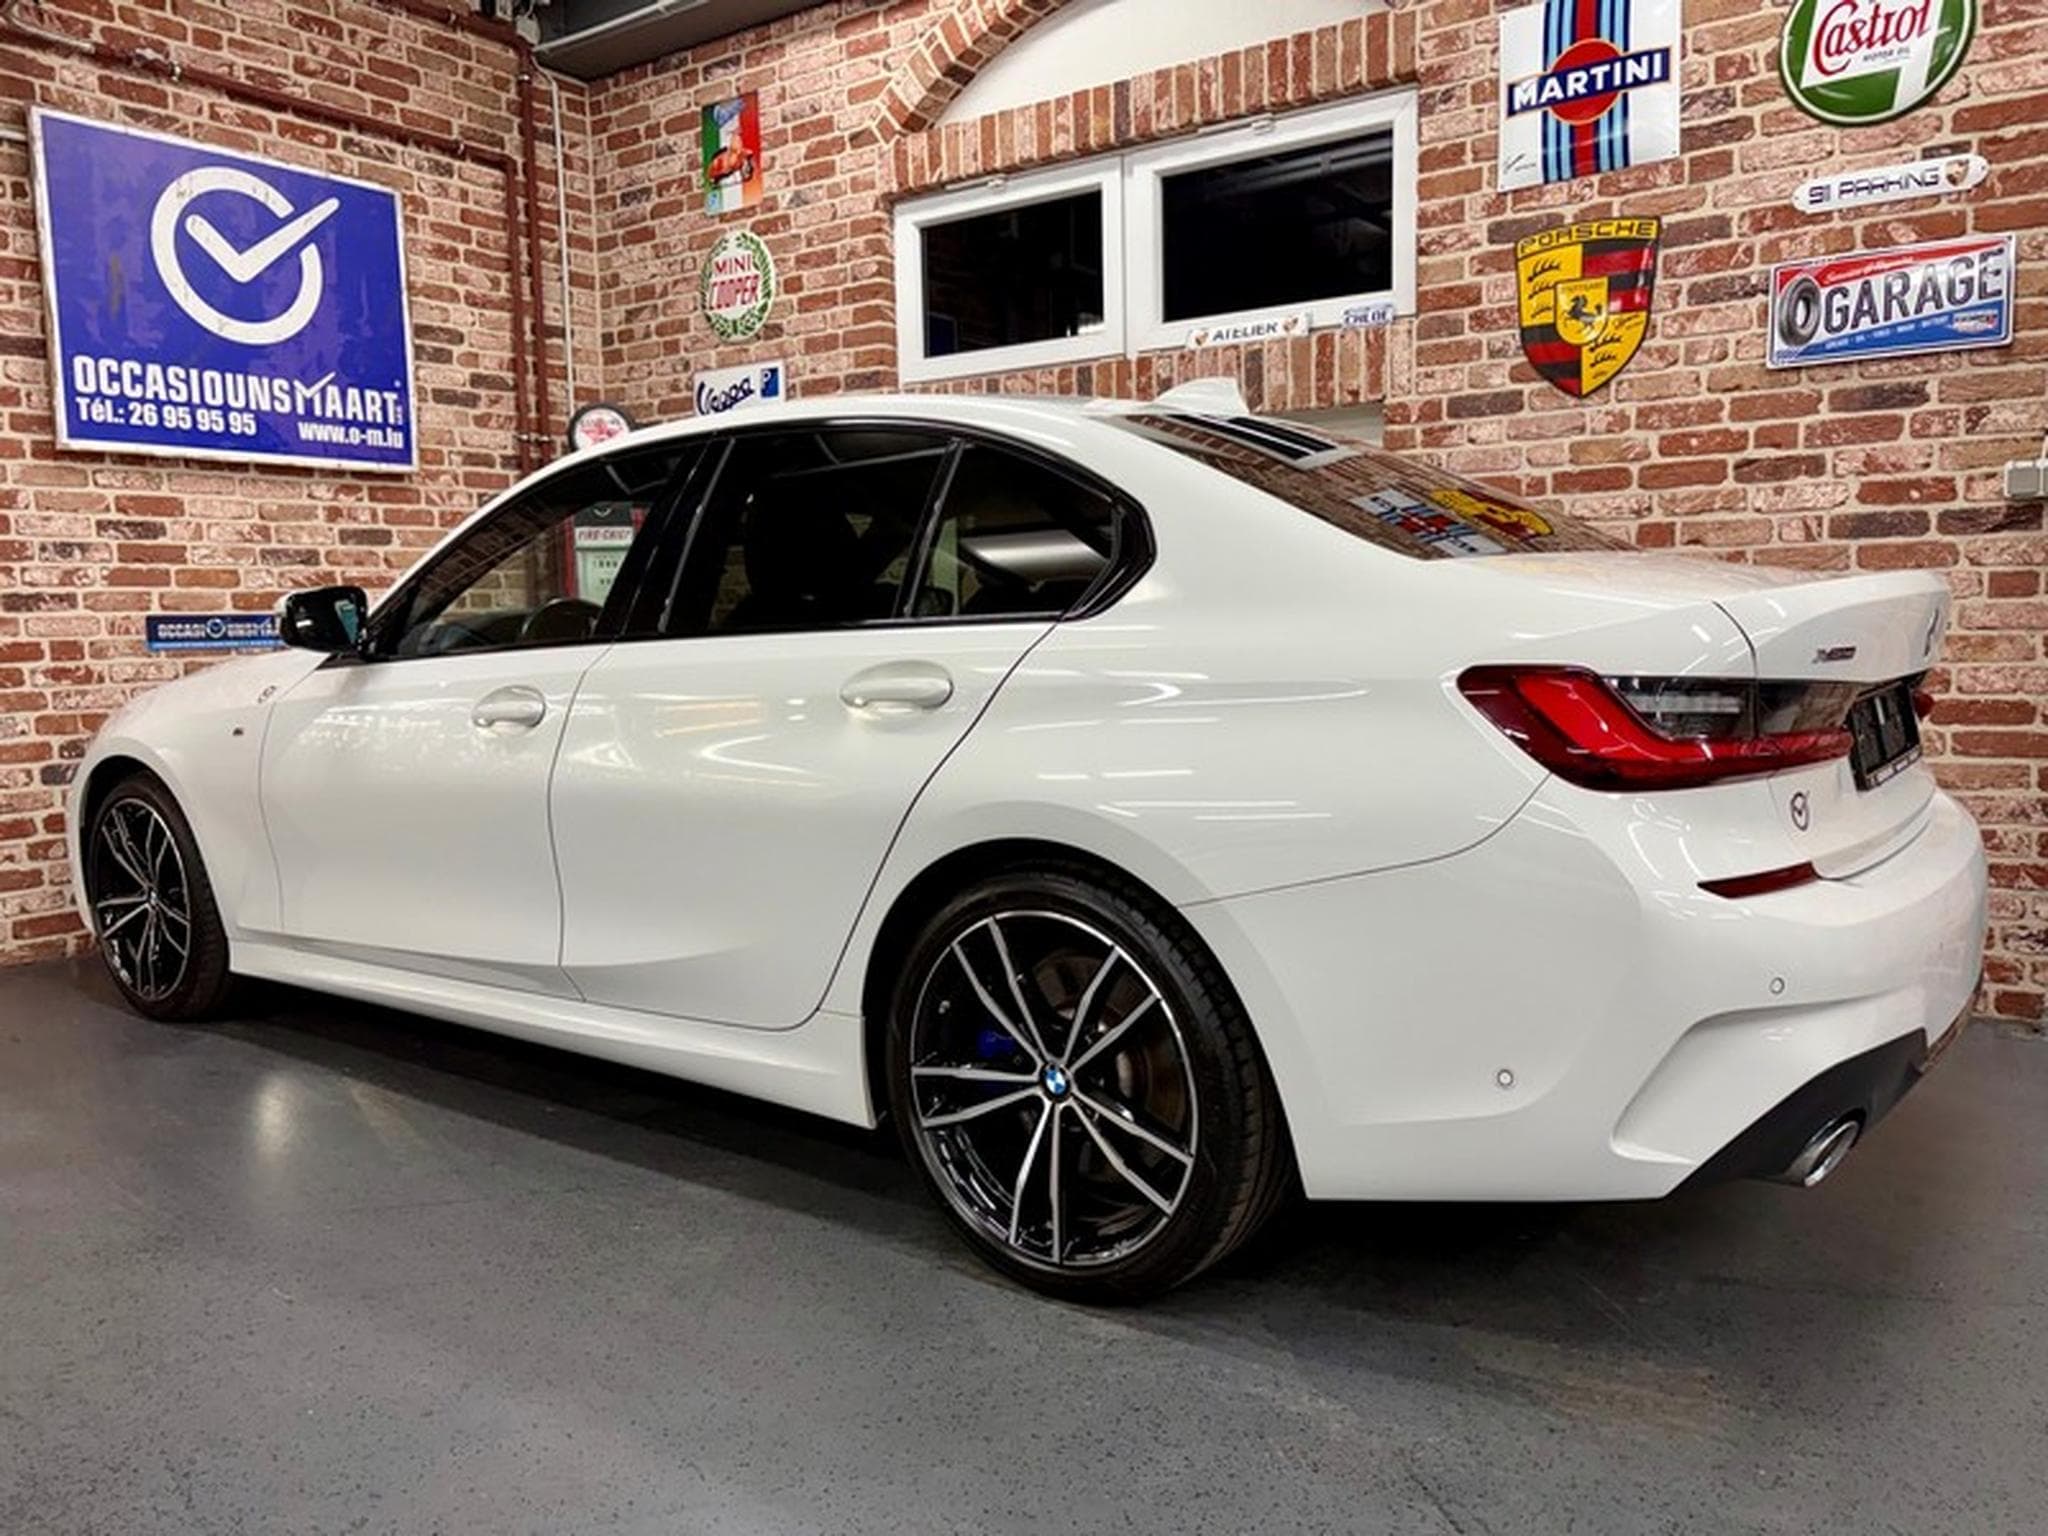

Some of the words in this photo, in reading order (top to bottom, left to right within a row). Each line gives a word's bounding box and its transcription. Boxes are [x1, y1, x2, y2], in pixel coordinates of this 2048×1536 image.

[1813, 0, 1931, 76] Castrol
[1513, 52, 1662, 111] MARTINI
[1838, 165, 1939, 199] PARKING
[1519, 220, 1655, 255] PORSCHE
[714, 253, 752, 276] MINI
[709, 273, 760, 311] COOPER
[1823, 247, 2005, 336] GARAGE
[1212, 321, 1279, 342] ATELIER
[696, 376, 755, 416] Vespa
[128, 401, 159, 427] 26
[162, 404, 193, 430] 95
[196, 408, 226, 434] 95
[228, 411, 258, 437] 95
[298, 421, 404, 449] www.o-m.lu
